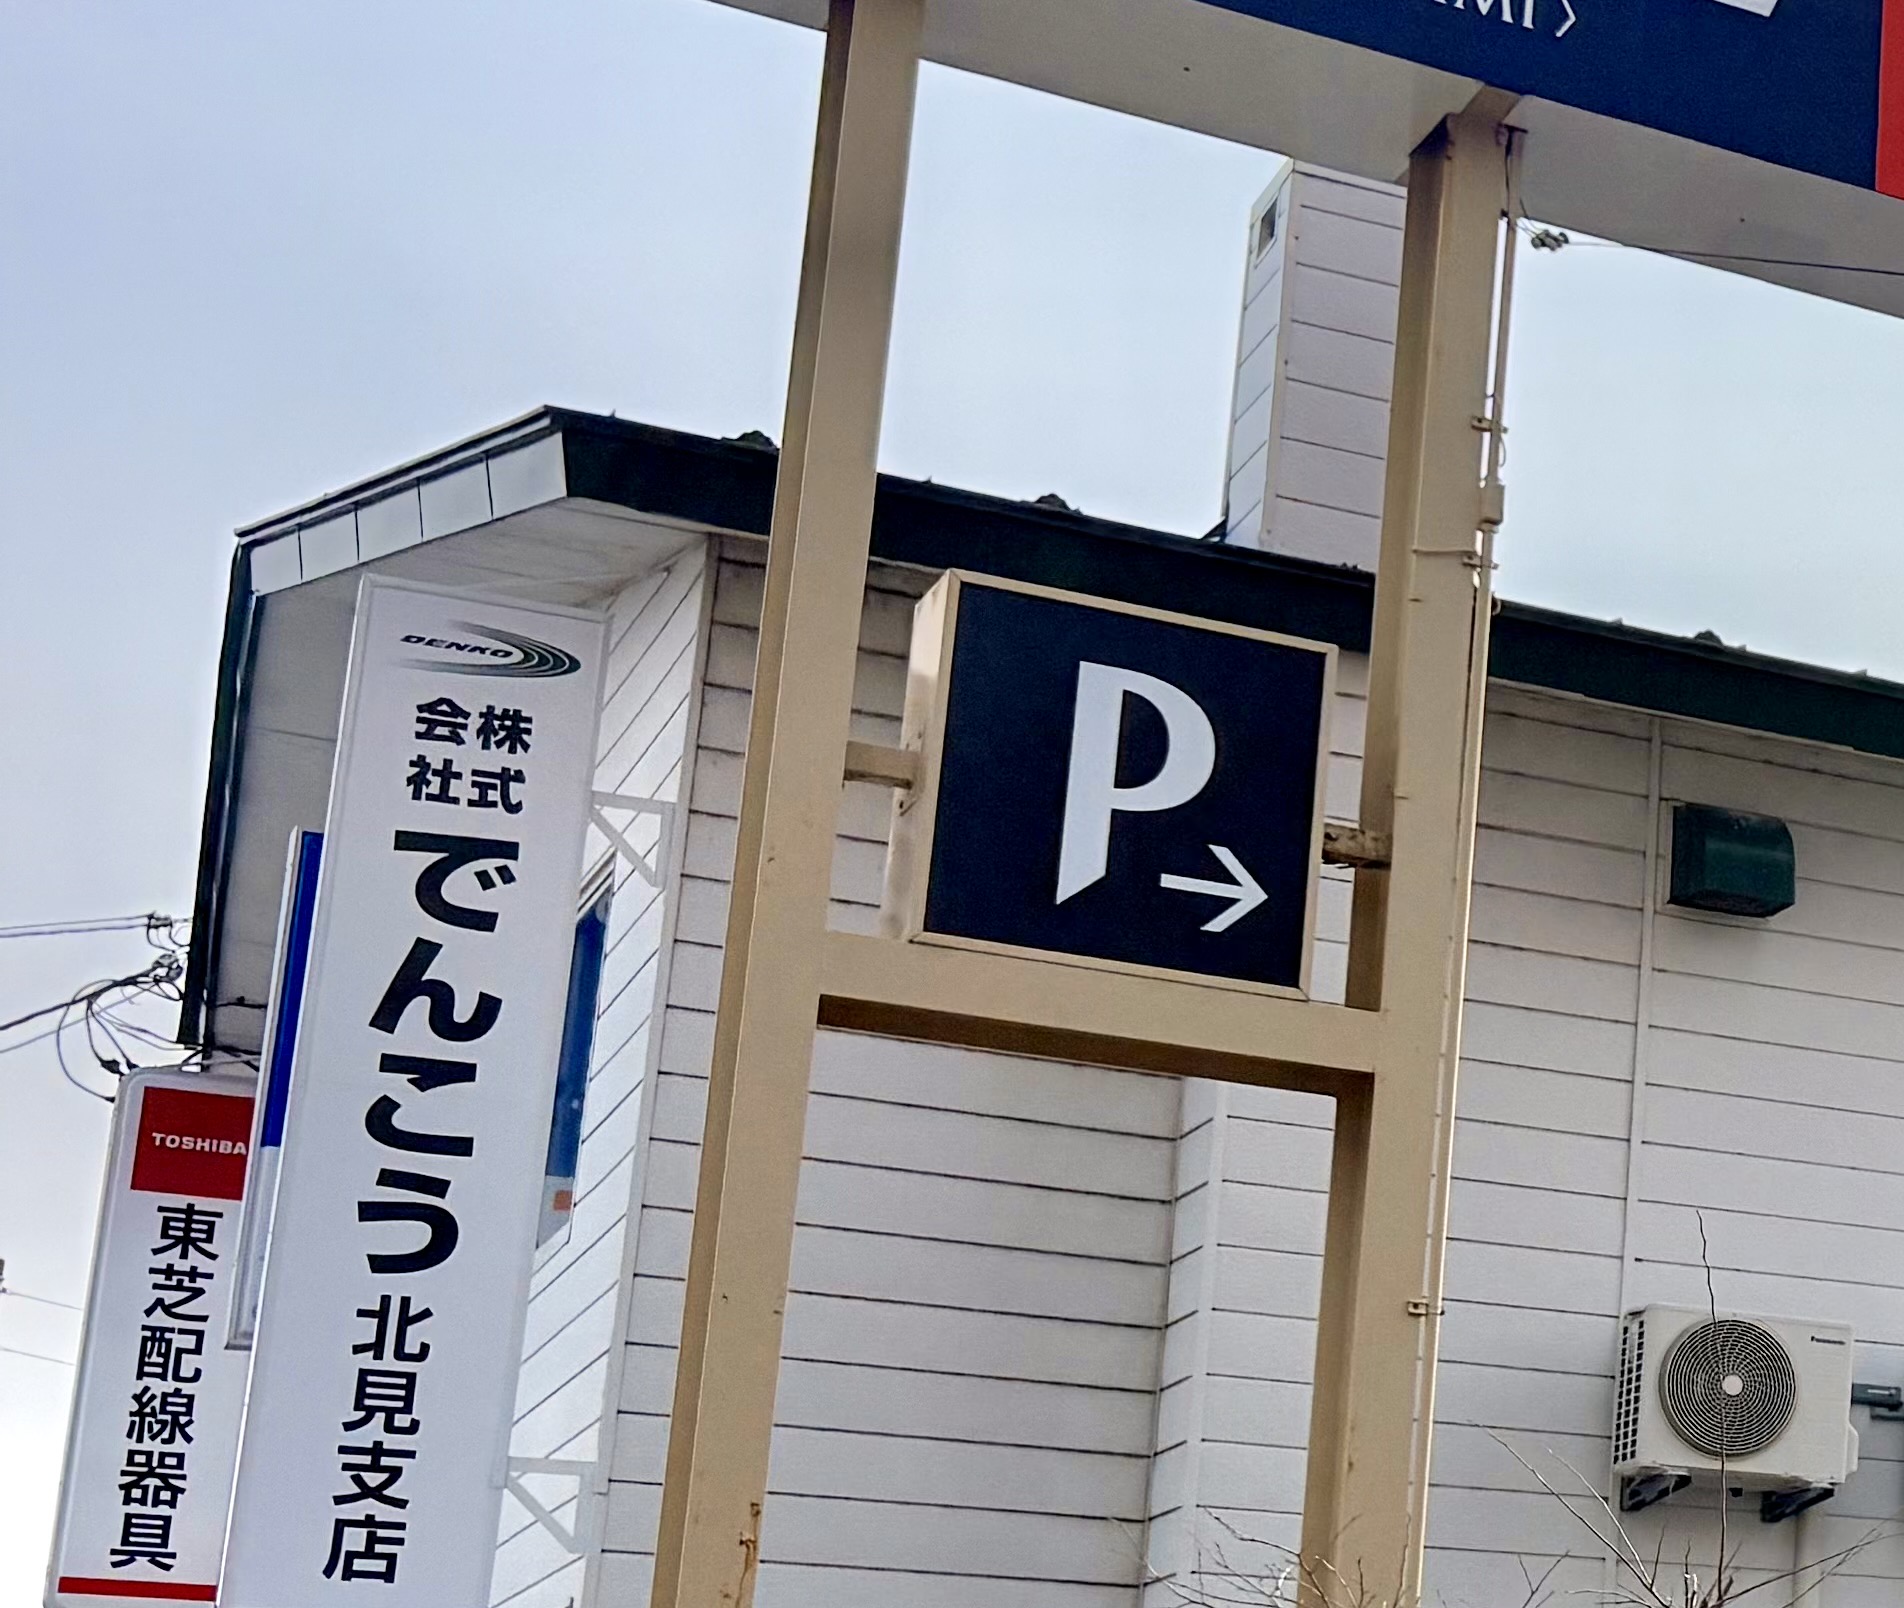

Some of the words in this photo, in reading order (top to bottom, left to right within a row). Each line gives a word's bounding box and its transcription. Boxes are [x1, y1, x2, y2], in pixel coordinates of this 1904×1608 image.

[400, 634, 514, 659] DENKO
[1056, 661, 1216, 905] P
[152, 1132, 248, 1156] TOSHIBA
[109, 1203, 224, 1572] 東芝配線器具
